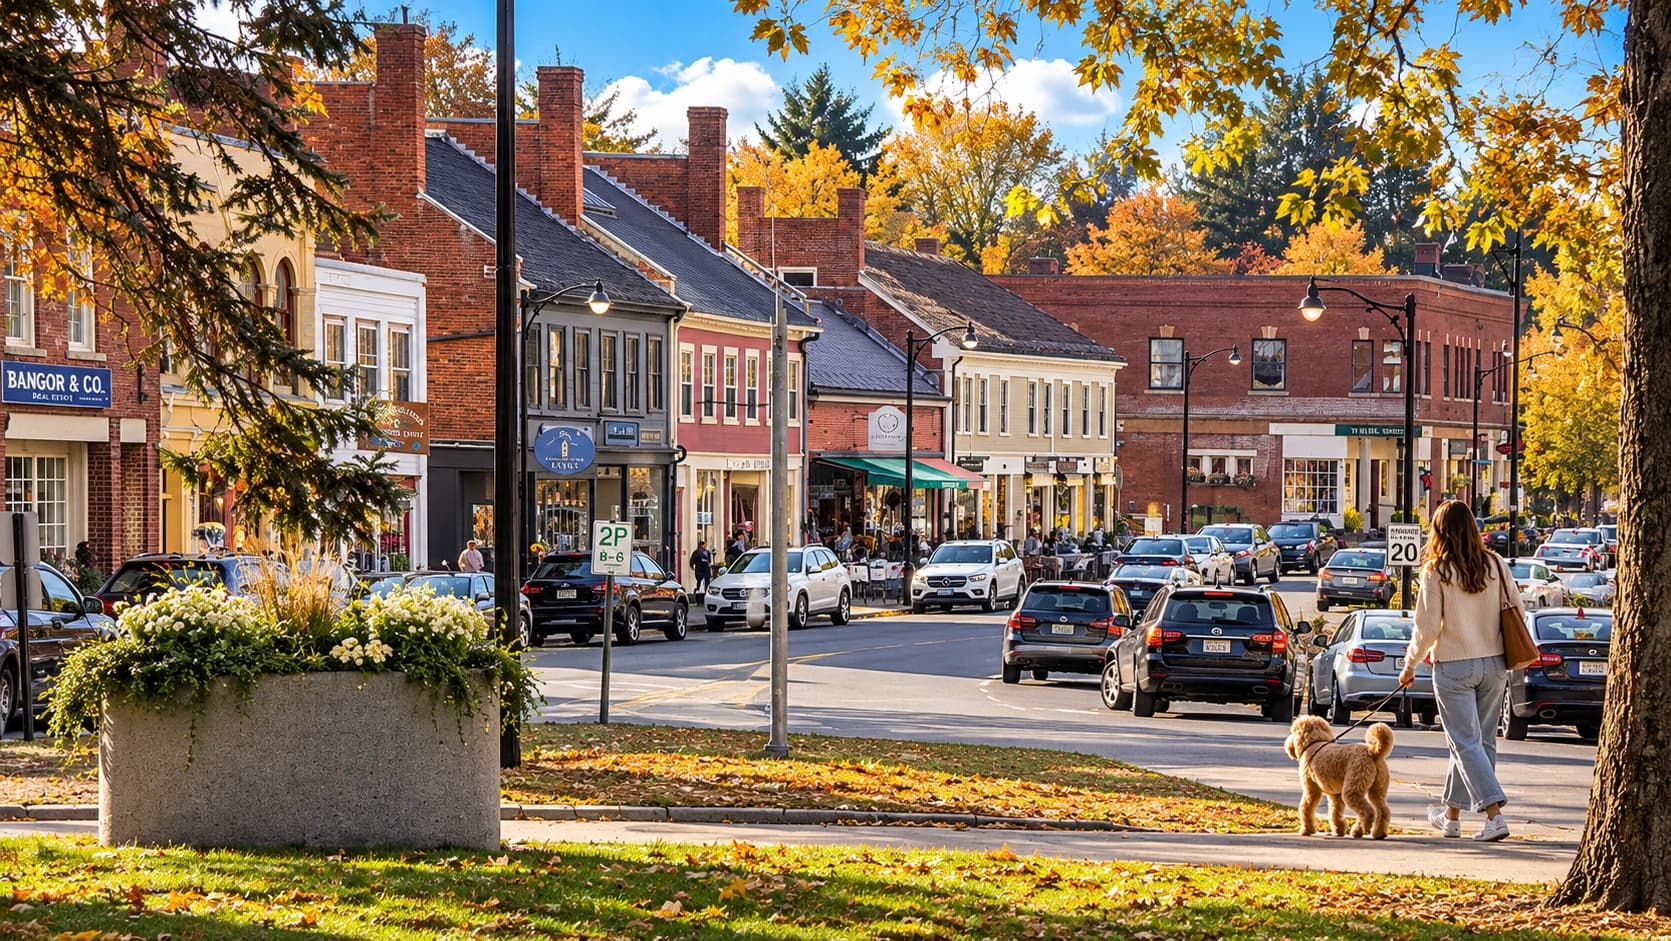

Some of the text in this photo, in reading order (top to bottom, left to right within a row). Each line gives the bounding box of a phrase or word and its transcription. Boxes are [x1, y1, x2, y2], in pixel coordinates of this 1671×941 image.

[7, 370, 106, 394] BANGOR & CO.
[599, 526, 628, 547] 2P
[1391, 542, 1418, 562] 20
